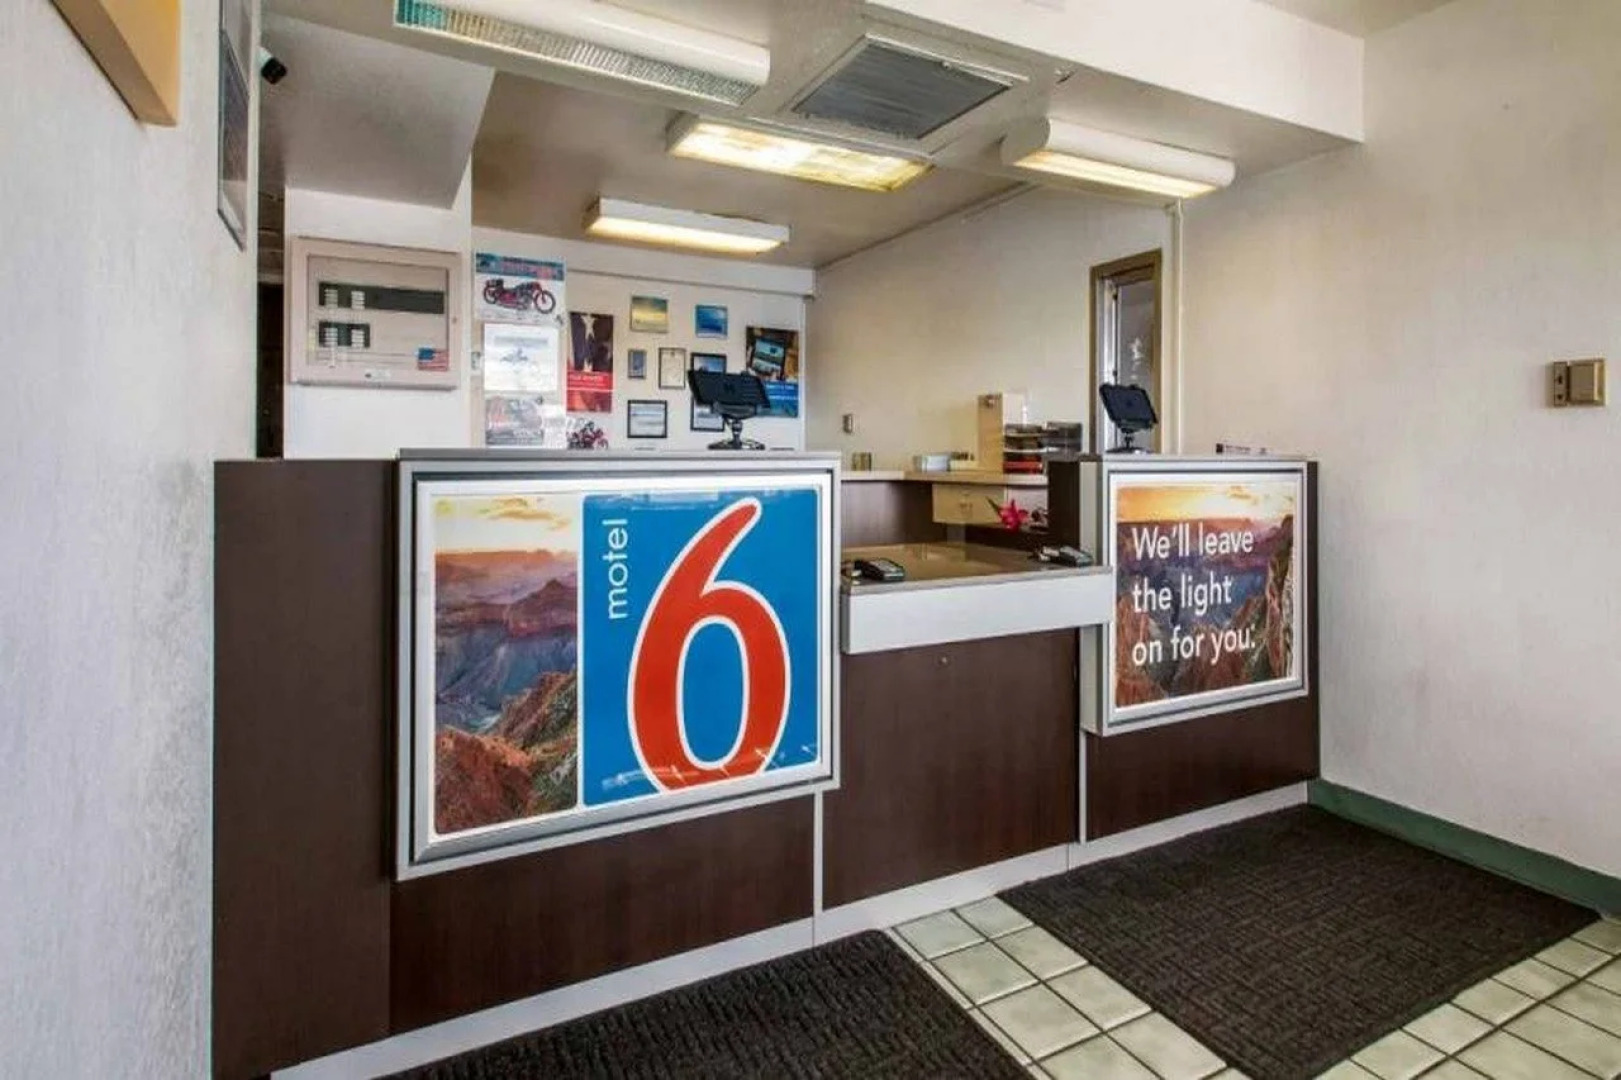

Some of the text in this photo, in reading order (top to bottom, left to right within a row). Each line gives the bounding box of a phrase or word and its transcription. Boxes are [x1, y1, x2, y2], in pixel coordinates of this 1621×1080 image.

[1132, 521, 1254, 561] We'll leave
[602, 518, 628, 619] motel
[1132, 571, 1232, 616] the light
[627, 496, 791, 794] 6
[1132, 639, 1162, 666] on
[1170, 624, 1205, 661] for
